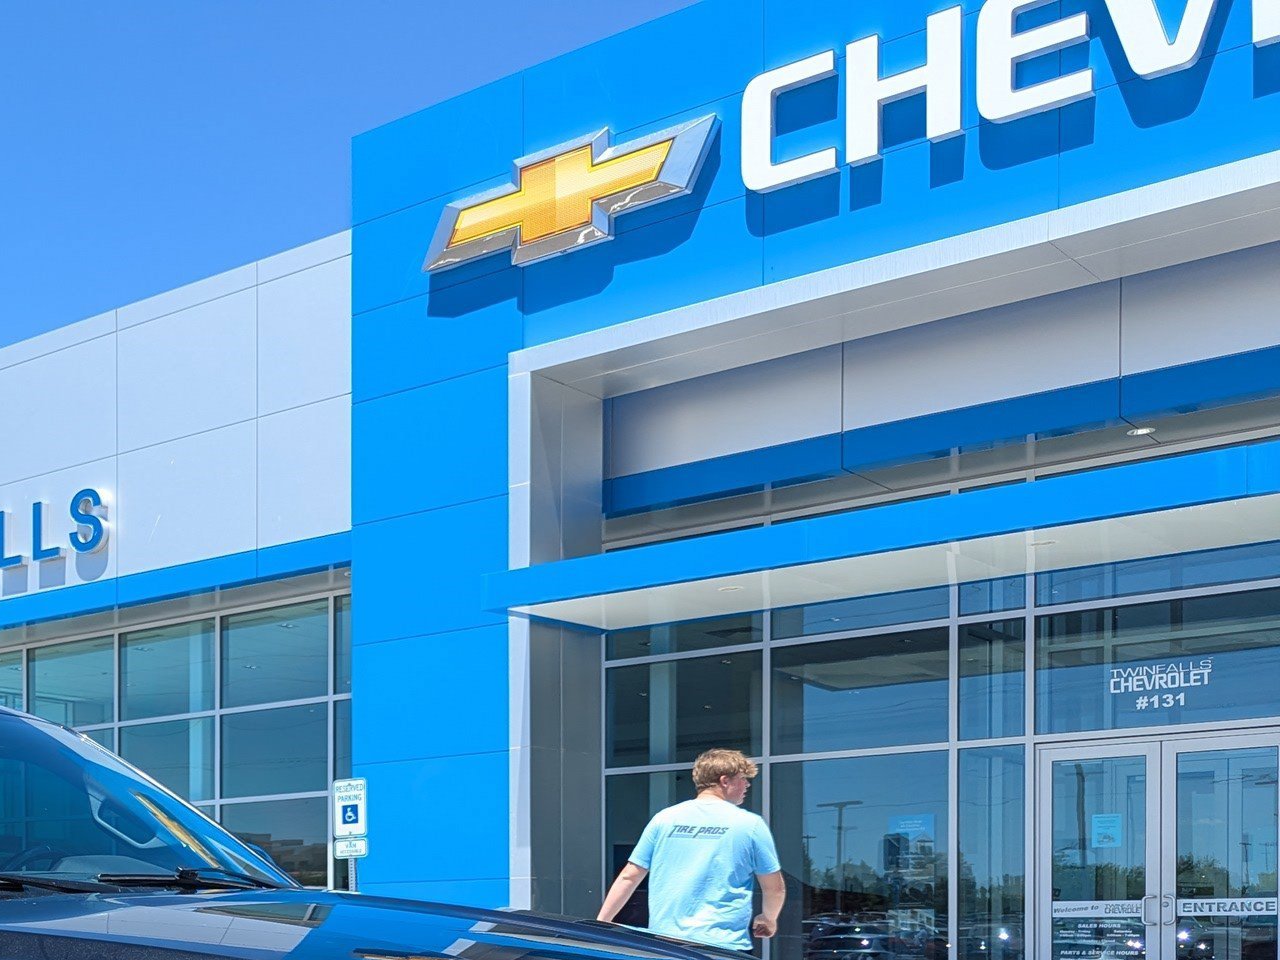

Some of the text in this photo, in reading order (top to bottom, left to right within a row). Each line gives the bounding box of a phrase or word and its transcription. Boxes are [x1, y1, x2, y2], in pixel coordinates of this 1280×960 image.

[741, 0, 1280, 193] CHEV
[1110, 669, 1212, 694] CHEVROLET
[1135, 692, 1185, 710] #131
[335, 783, 364, 793] RESERVED
[337, 794, 362, 803] PARKING
[669, 824, 730, 839] TIRE PROS
[1053, 906, 1088, 914] Welcome
[1182, 901, 1276, 913] ENTRANCE
